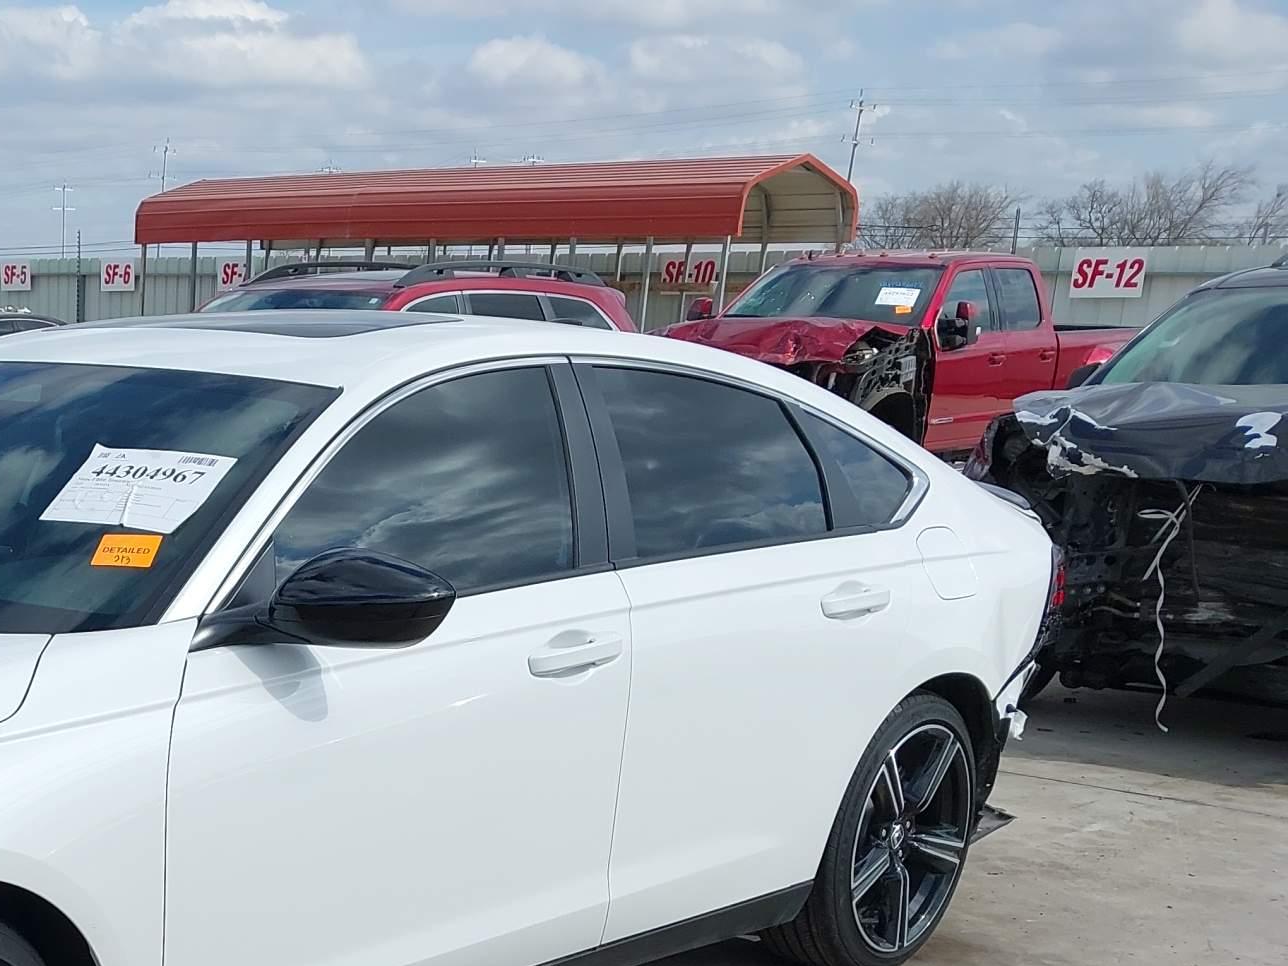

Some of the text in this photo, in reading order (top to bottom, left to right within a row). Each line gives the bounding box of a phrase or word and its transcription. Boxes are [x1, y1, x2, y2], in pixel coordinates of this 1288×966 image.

[3, 265, 27, 285] SF-5
[103, 264, 131, 285] SF-6
[1072, 258, 1145, 289] SF-12
[92, 464, 207, 485] 44304967
[102, 546, 151, 555] DETAILED
